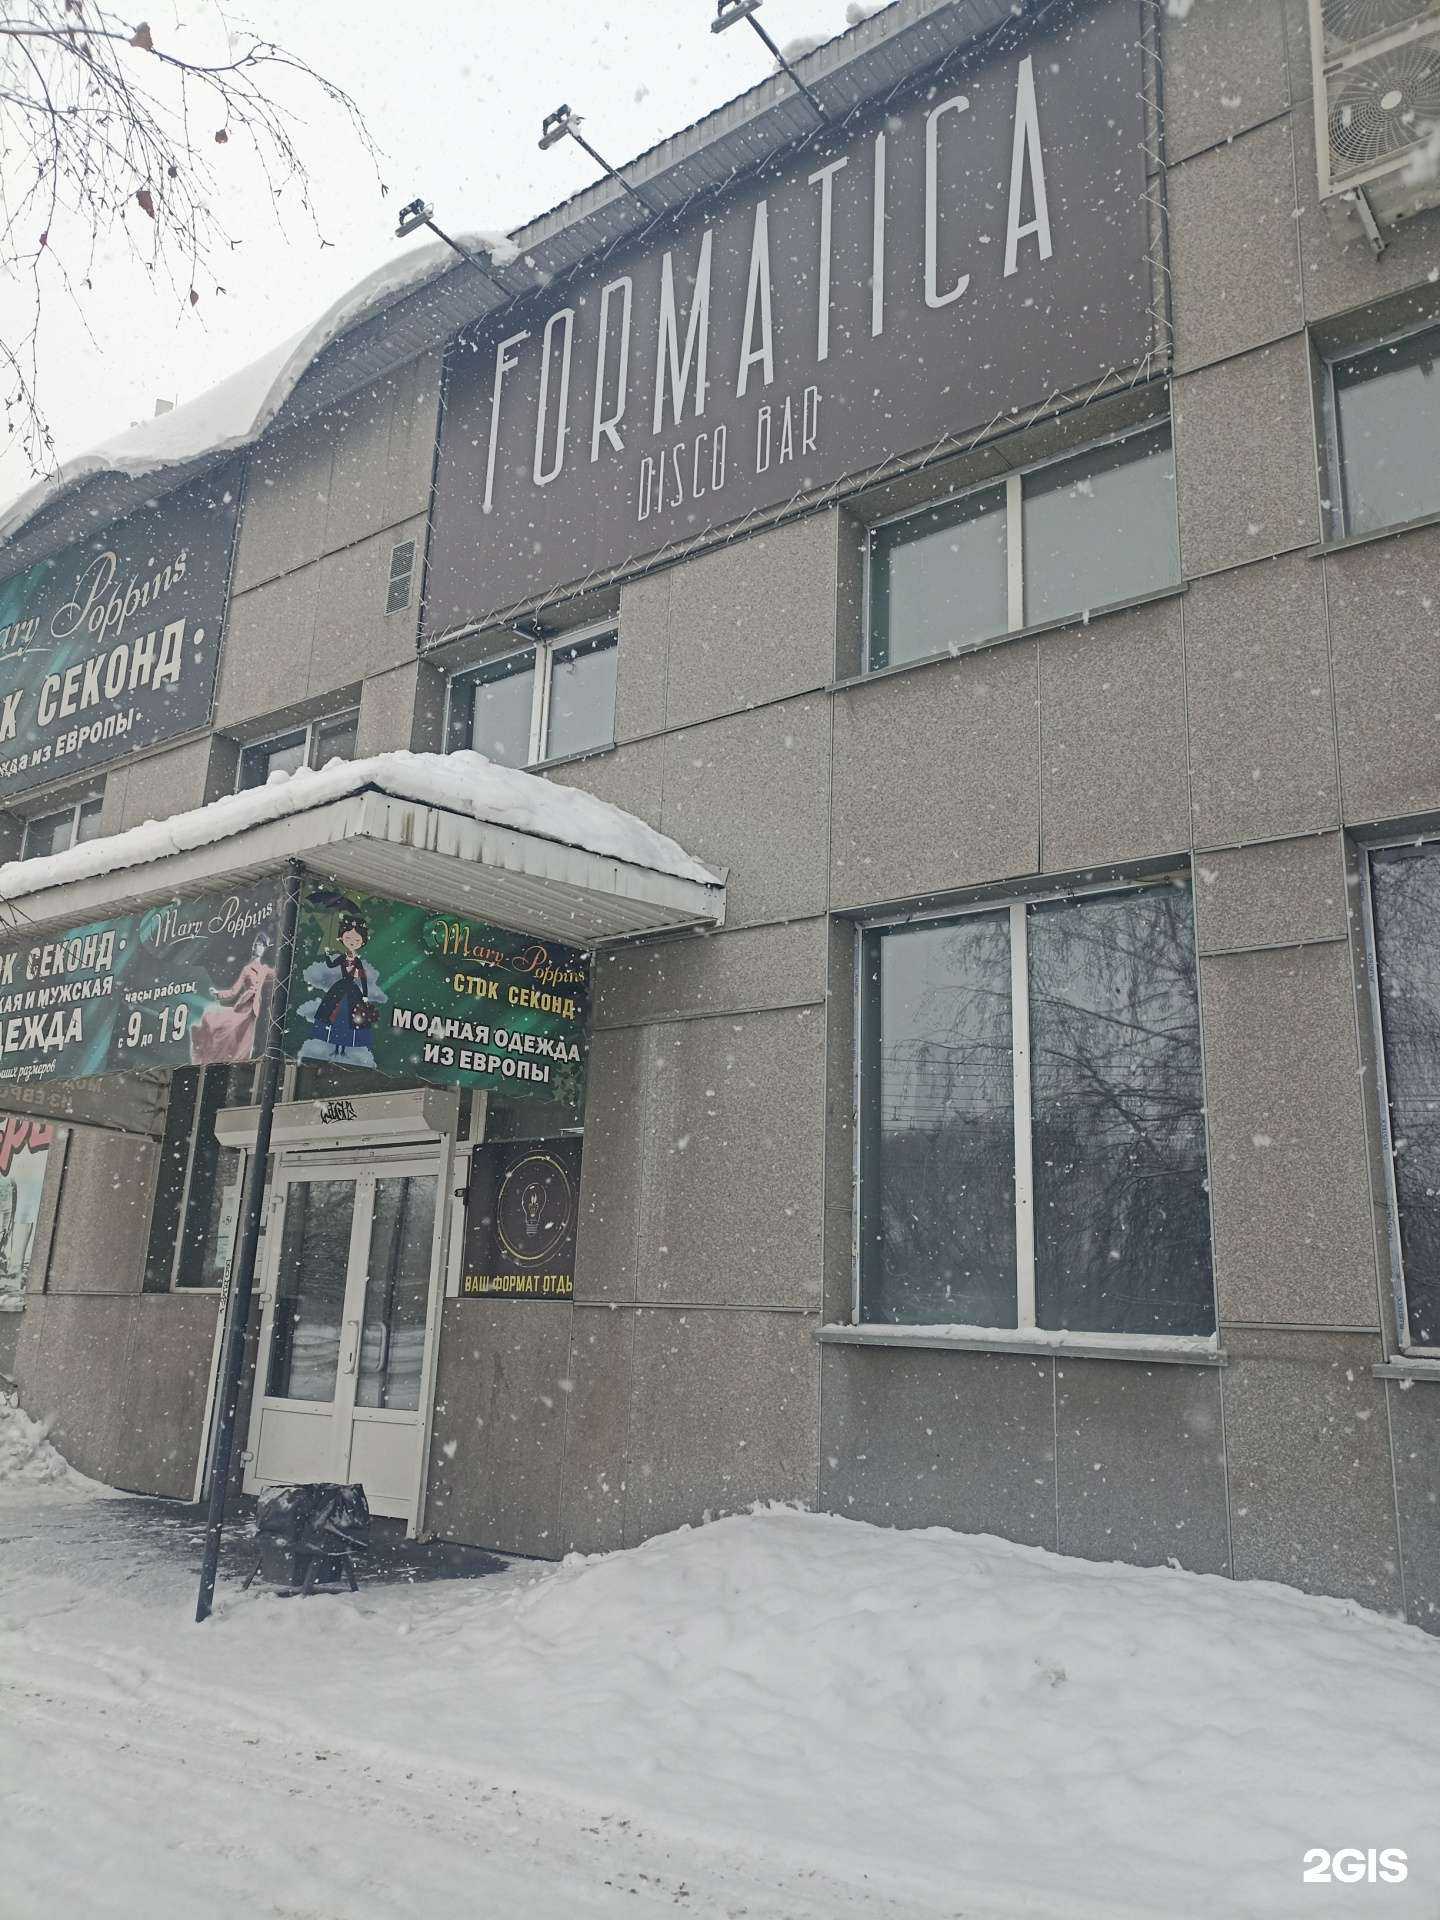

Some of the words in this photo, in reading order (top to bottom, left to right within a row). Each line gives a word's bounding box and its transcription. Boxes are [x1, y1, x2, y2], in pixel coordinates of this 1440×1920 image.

[483, 54, 1053, 514] FORMATICA
[637, 425, 727, 521] DISCO
[756, 385, 820, 474] BAR
[51, 551, 187, 643] Poppins
[37, 617, 187, 727] СЕКОНД
[55, 708, 134, 758] ЕВРОПЫ
[151, 909, 203, 947] Mary
[208, 895, 273, 938] Poppins
[26, 930, 116, 980] СЕКОНД
[437, 920, 505, 965] Mary
[511, 945, 585, 988] Poppins
[37, 976, 114, 1008] МУЖСКАЯ
[125, 989, 152, 1002] часы
[153, 981, 196, 1000] работы
[453, 973, 500, 1000] СТОК
[508, 985, 577, 1020] СЕКОНД
[0, 1007, 83, 1058] ЕЖДА
[126, 1011, 142, 1047] 9
[140, 1033, 153, 1047] до
[159, 1004, 188, 1043] 19
[392, 1008, 490, 1044] МОДНАЯ
[494, 1030, 582, 1062] ОДЕЖДА
[423, 1043, 455, 1066] ИЗ
[459, 1051, 551, 1083] ЕВРОПЫ
[464, 1275, 490, 1292] ВАШ
[492, 1275, 540, 1292] ФОРМАТ
